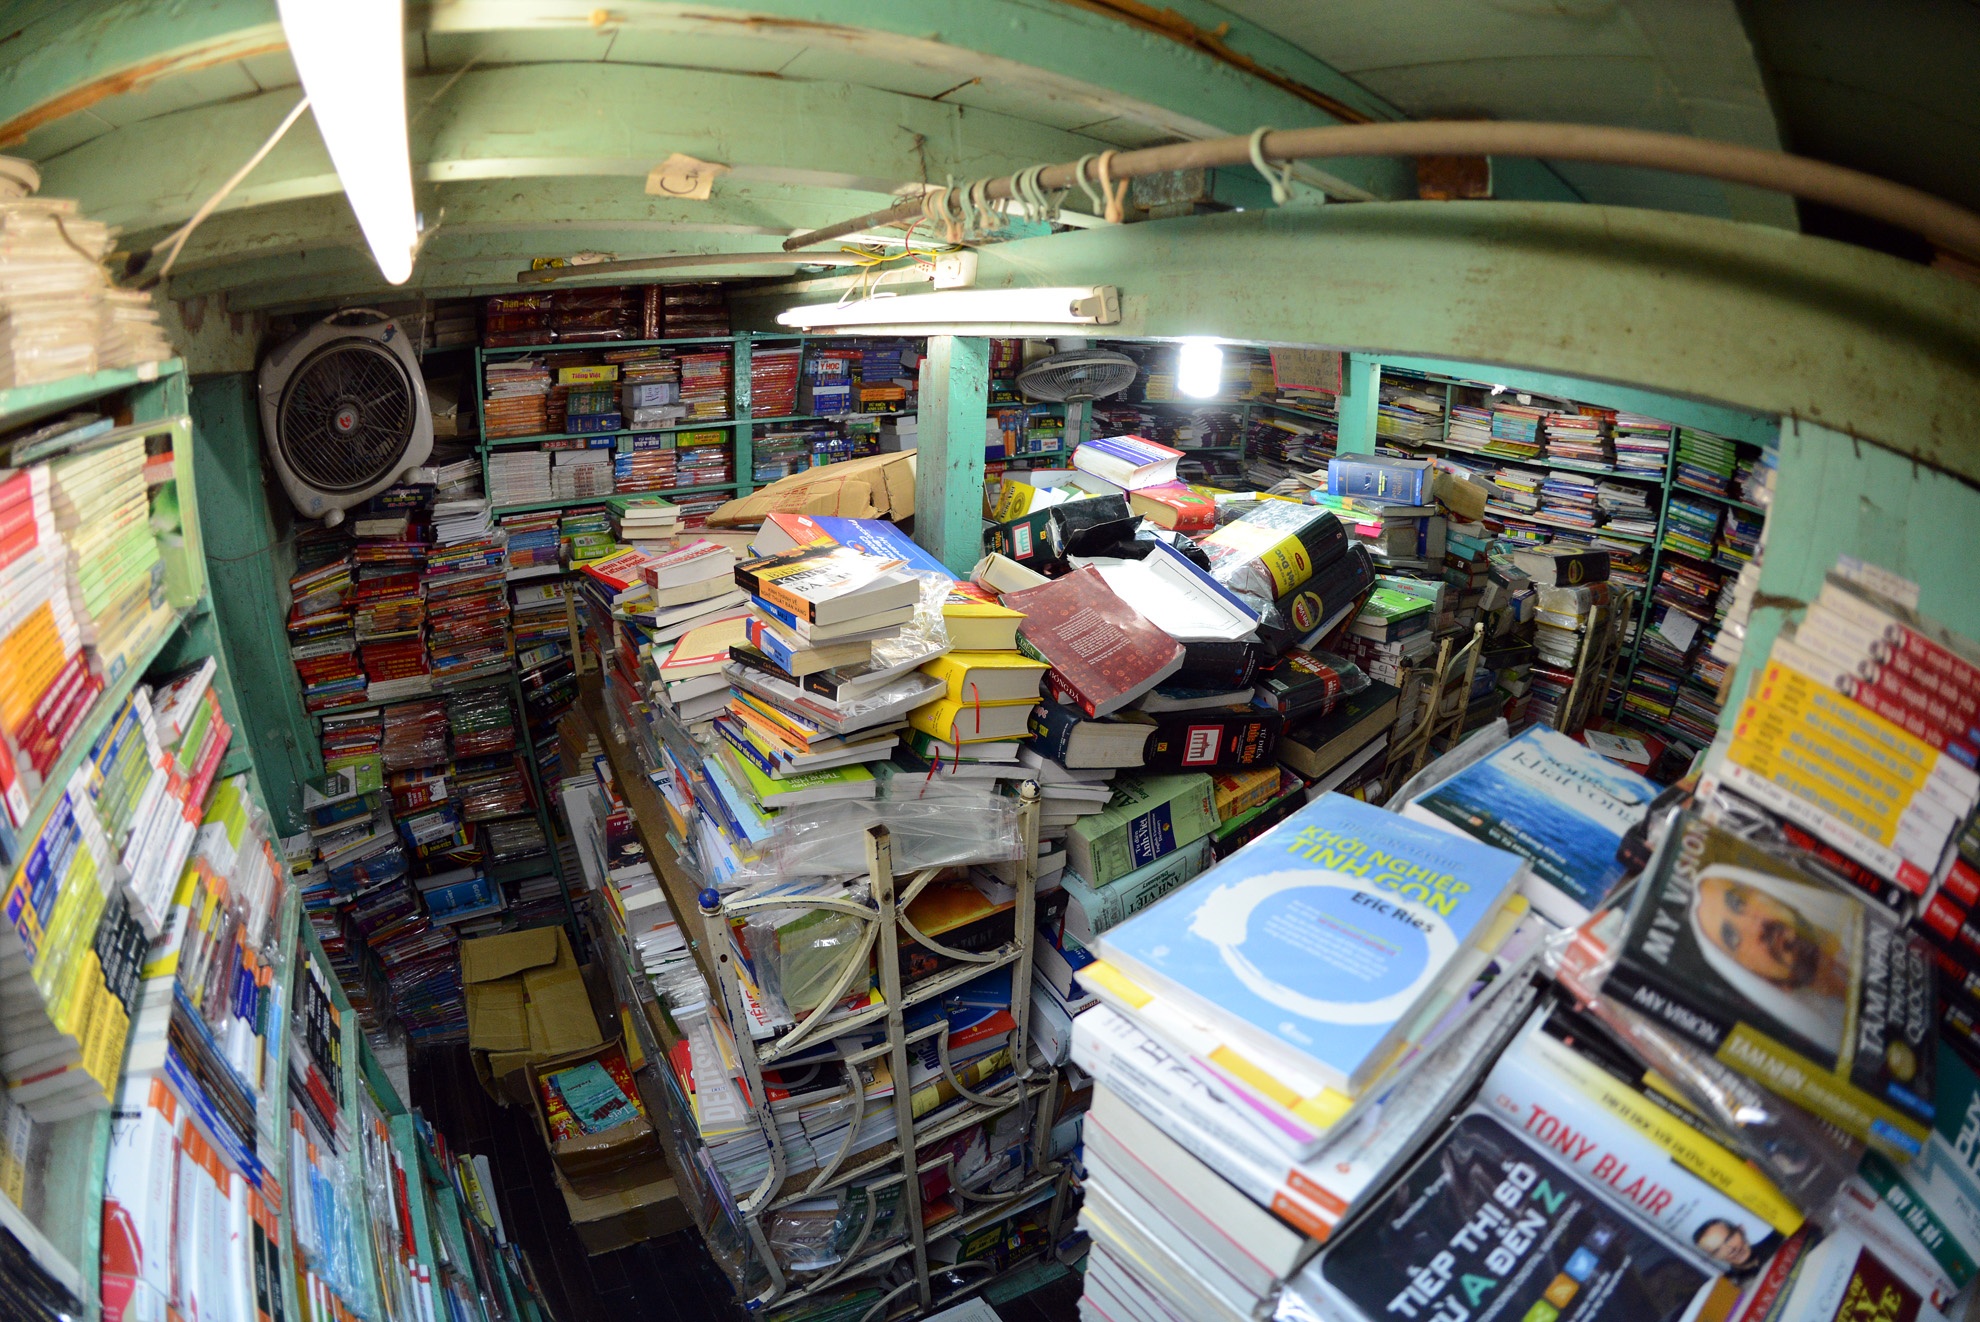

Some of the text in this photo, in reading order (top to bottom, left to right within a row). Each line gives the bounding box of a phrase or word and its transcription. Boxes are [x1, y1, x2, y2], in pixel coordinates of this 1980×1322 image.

[1140, 818, 1152, 857] Anh-Việt
[1287, 836, 1372, 877] TINH
[1300, 824, 1472, 896] KHỞI NGHIỆP
[1129, 872, 1182, 915] ANH VIỆT
[1350, 891, 1436, 933] Eric Ries
[1642, 822, 1712, 964] MY VISION
[592, 1097, 628, 1122] Talk
[1523, 1104, 1597, 1165] TONY
[1591, 1153, 1674, 1217] BLAIR
[1386, 1250, 1456, 1318] TIẾP
[1493, 1160, 1537, 1209] SỐ
[1460, 1273, 1498, 1307] A
[1484, 1208, 1547, 1276] ĐẾN
[1531, 1178, 1567, 1214] Z
